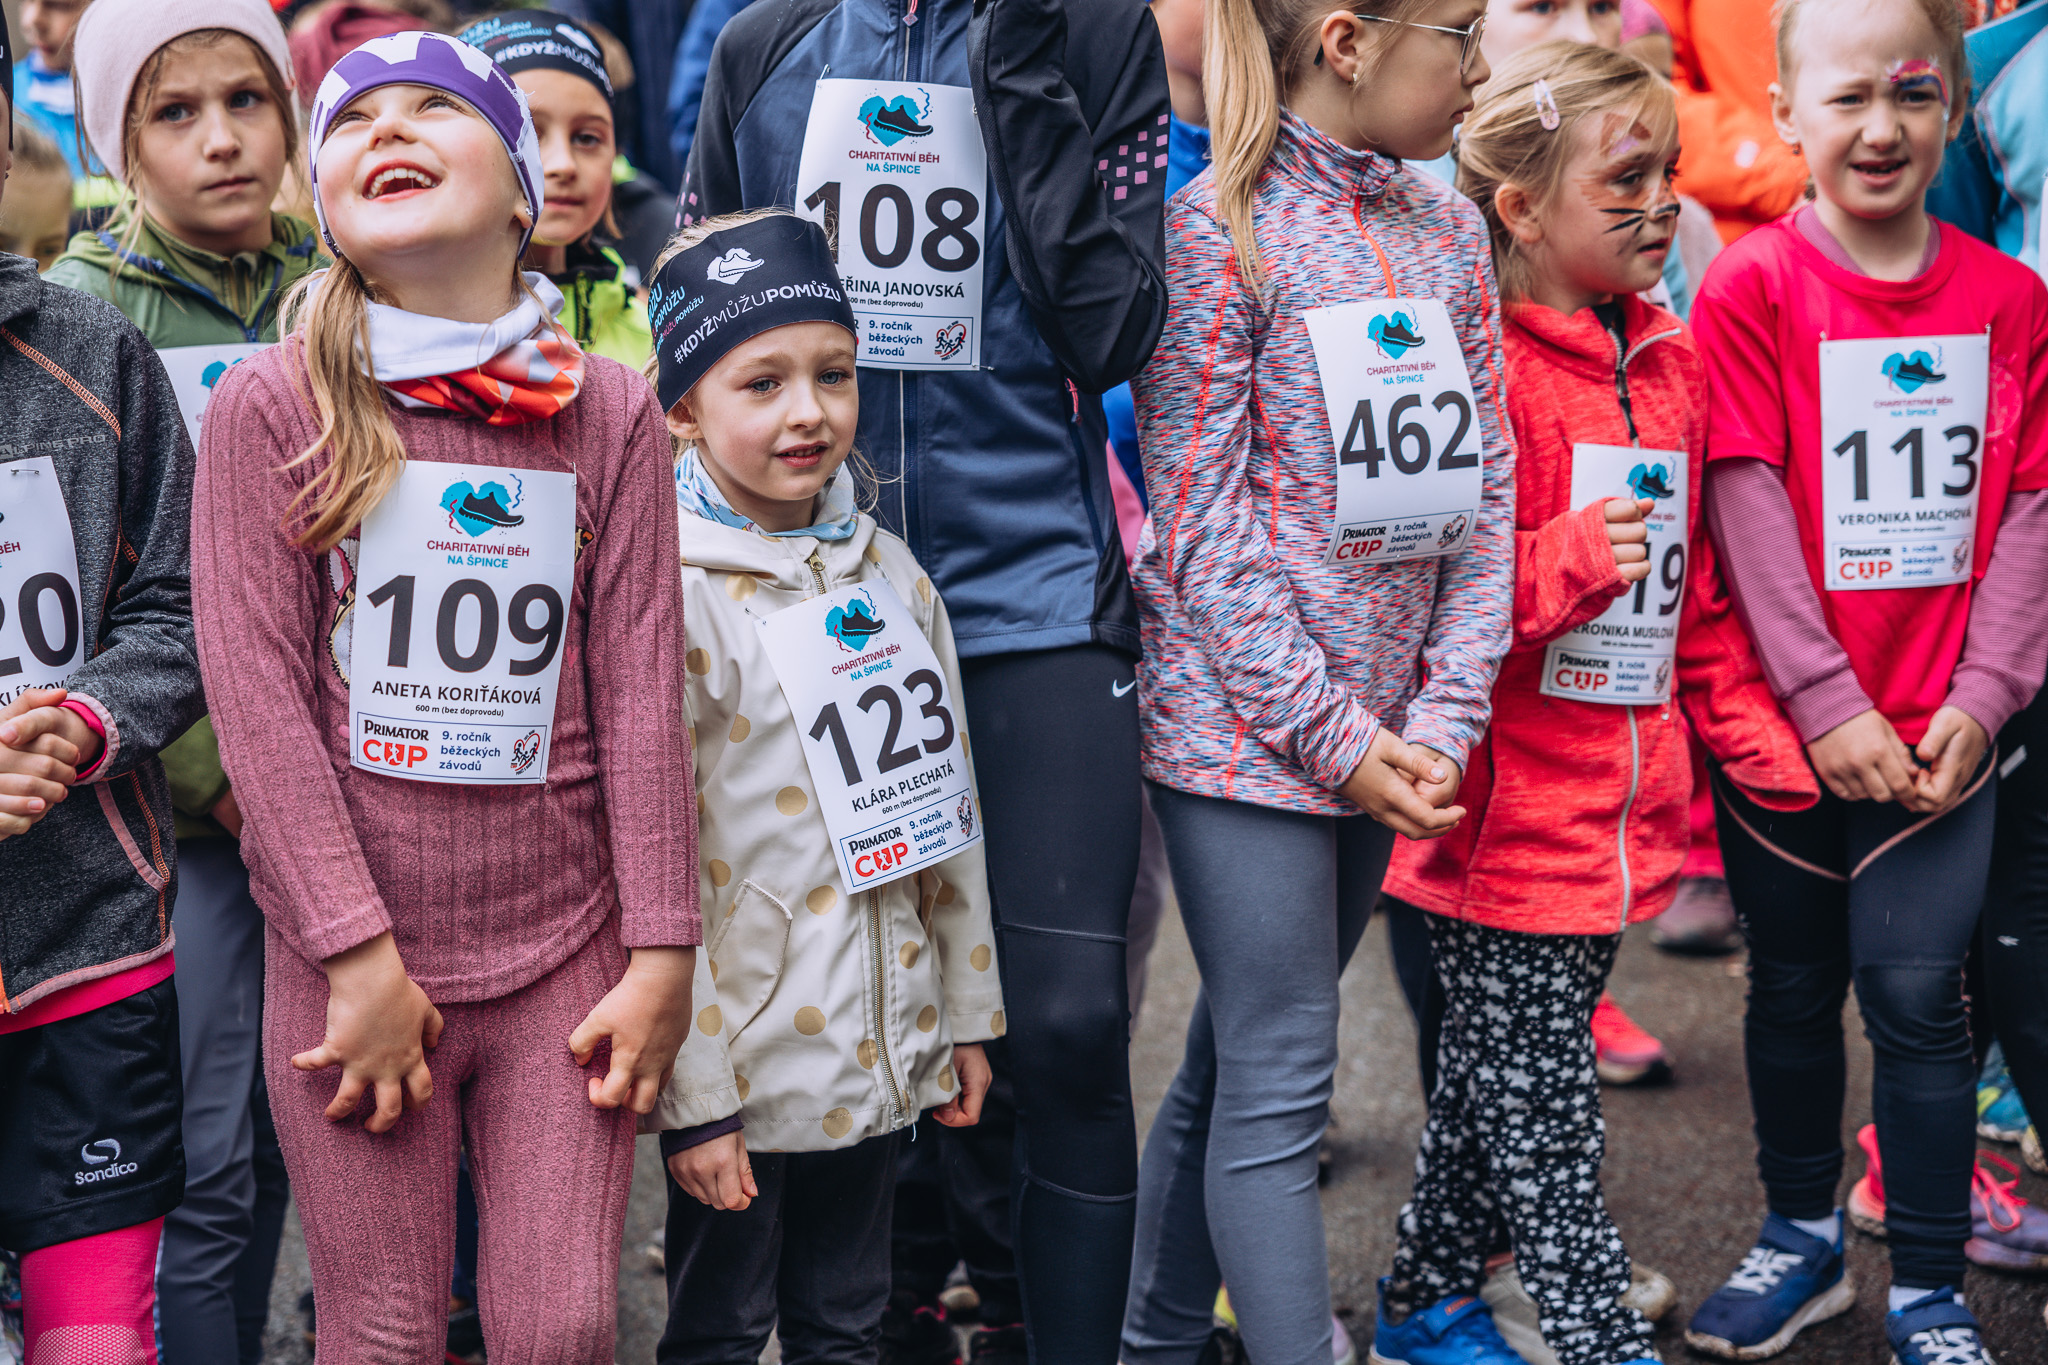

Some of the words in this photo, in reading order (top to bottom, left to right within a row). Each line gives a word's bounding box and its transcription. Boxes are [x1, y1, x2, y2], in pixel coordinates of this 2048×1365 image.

[848, 150, 917, 163] CHARITATIVNÍ
[919, 151, 940, 164] BĚH
[866, 163, 881, 173] NA
[883, 161, 921, 174] ŠPINCE
[803, 181, 981, 273] 108
[883, 281, 965, 298] JANOVSKÁ
[867, 298, 881, 306] (bez
[883, 299, 924, 309] doprovodu)
[674, 280, 842, 364] #KDYŽMŮŽUPOMŮŽU
[869, 319, 878, 329] 9.
[881, 321, 913, 331] ročník
[868, 333, 923, 346] běžeckých
[868, 346, 905, 357] závodů
[1366, 362, 1420, 376] CHARITATIVNÍ
[1421, 361, 1436, 371] BĚH
[1383, 377, 1395, 385] NA
[1396, 373, 1425, 385] ŠPINCE
[67, 434, 106, 449] PRO
[1339, 390, 1479, 479] 462
[1832, 424, 1980, 501] 113
[1838, 511, 1911, 525] VERONIKA
[1915, 503, 1972, 521] MACHOVÁ
[1342, 526, 1386, 541] PRIMATOR
[1394, 524, 1402, 532] 9.
[1403, 521, 1428, 531] ročník
[1391, 532, 1432, 543] běžeckých
[426, 540, 505, 556] CHARITATIVNÍ
[507, 541, 530, 557] BĚH
[1336, 540, 1383, 559] CUP
[1386, 543, 1416, 553] závodů
[447, 555, 464, 566] NA
[467, 554, 509, 568] ŠPINCE
[1839, 561, 1893, 580] CUP
[1632, 542, 1686, 617] 19
[367, 574, 565, 677] 109
[1572, 623, 1630, 637] ERONIKA
[1633, 625, 1674, 638] MUSILOVÁ
[831, 647, 886, 676] CHARITATIVNÍ
[885, 643, 902, 656] BĚH
[1558, 652, 1610, 669] PRIMATOR
[850, 671, 863, 682] NA
[863, 659, 893, 677] ŠPINCE
[1555, 669, 1609, 692] CUP
[371, 680, 432, 700] ANETA
[438, 684, 542, 704] KORIŤÁKOVÁ
[415, 704, 430, 713] 600
[441, 705, 458, 716] (bez
[460, 706, 504, 718] doprovodu)
[363, 719, 429, 741] PRIMATOR
[442, 730, 453, 741] 9.
[456, 731, 492, 743] ročník
[808, 668, 955, 787] 123
[362, 739, 428, 768] CUP
[440, 745, 501, 760] běžeckých
[439, 759, 482, 772] závodů
[852, 785, 898, 812] KLÁRA
[898, 758, 955, 795] PLECHATÁ
[882, 805, 893, 814] 600
[900, 797, 912, 809] (bez
[912, 786, 941, 803] doprovodu)
[909, 820, 918, 829] 9.
[919, 810, 943, 827] ročník
[913, 820, 953, 842] běžeckých
[848, 826, 903, 856] PRIMATOR
[918, 836, 947, 855] závodů
[855, 842, 908, 877] CUP
